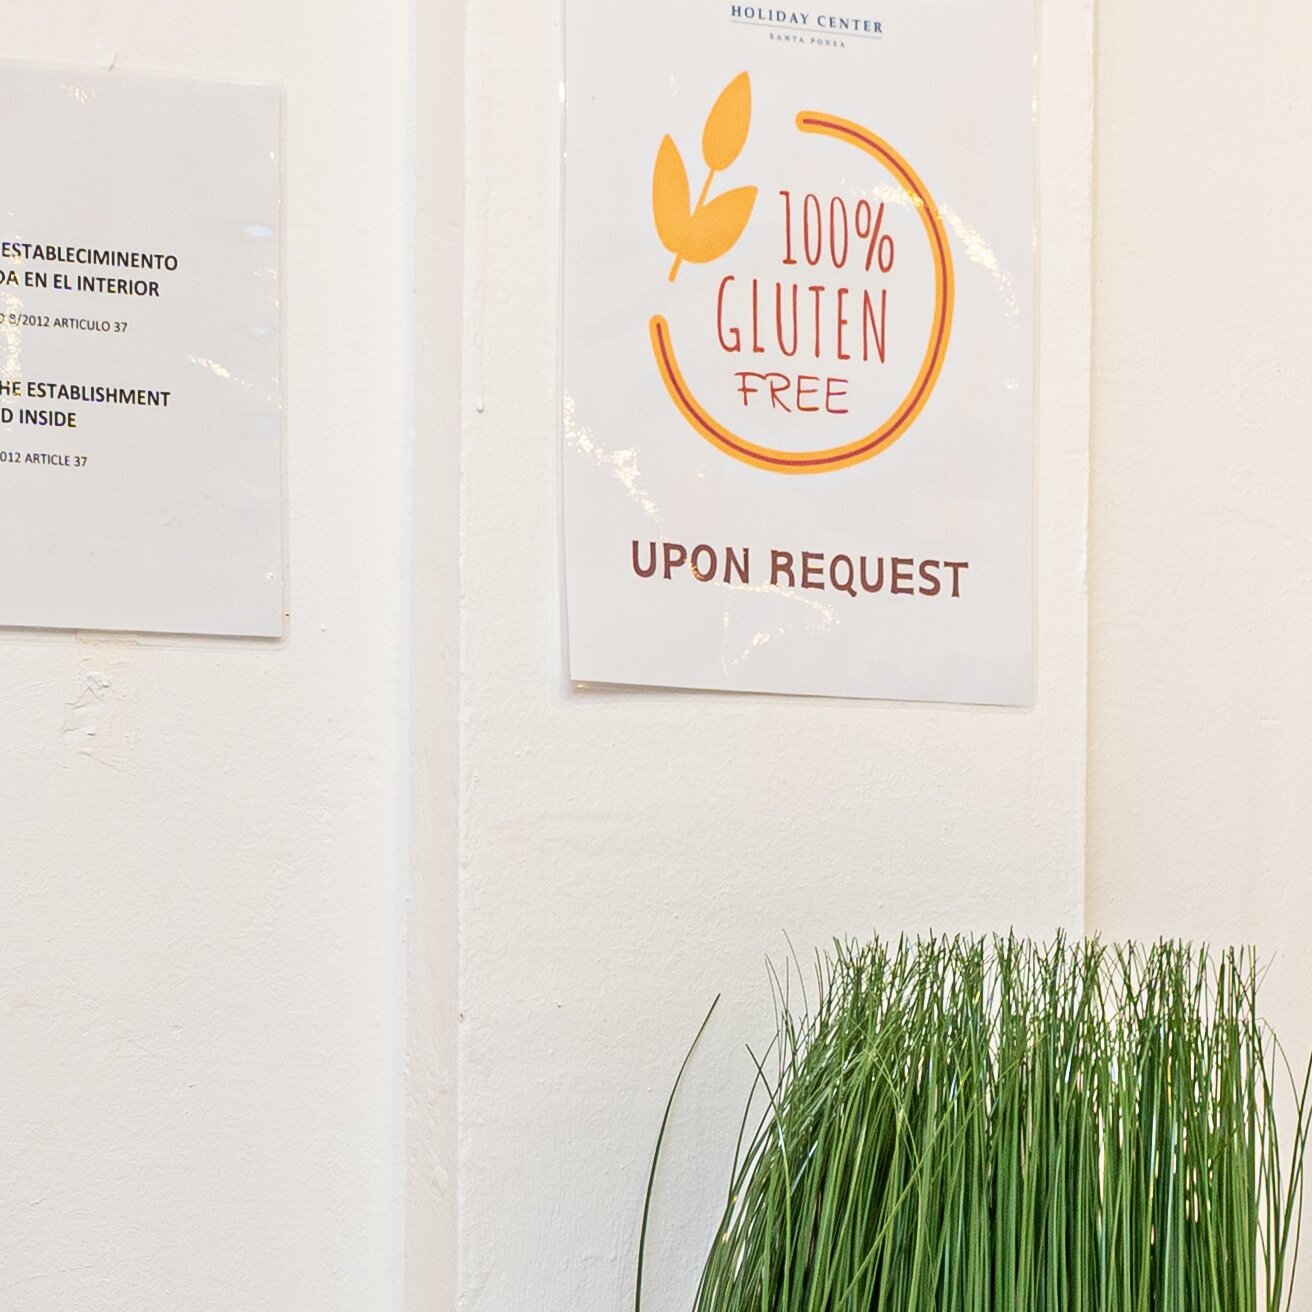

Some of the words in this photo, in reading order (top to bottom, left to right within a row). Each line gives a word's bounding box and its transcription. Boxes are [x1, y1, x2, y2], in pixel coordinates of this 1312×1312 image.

[732, 5, 808, 24] HOLIDAY
[818, 15, 882, 33] CENTER
[770, 33, 804, 44] SANTA
[780, 190, 896, 274] 100%
[2, 242, 178, 270] ESTABLECIMINENTO
[25, 272, 46, 288] EN
[54, 274, 72, 290] EL
[78, 276, 160, 297] INTERIOR
[8, 314, 49, 328] 8/2012
[54, 318, 110, 332] ARTICULO
[114, 322, 128, 332] 37
[716, 275, 888, 364] GLUTEN
[28, 382, 170, 407] ESTABLISHMENT
[734, 372, 850, 414] FREE
[20, 409, 77, 428] INSIDE
[25, 453, 70, 466] ARTICLE
[74, 456, 88, 467] 37
[631, 539, 750, 584] UPON
[770, 549, 969, 598] REQUEST
